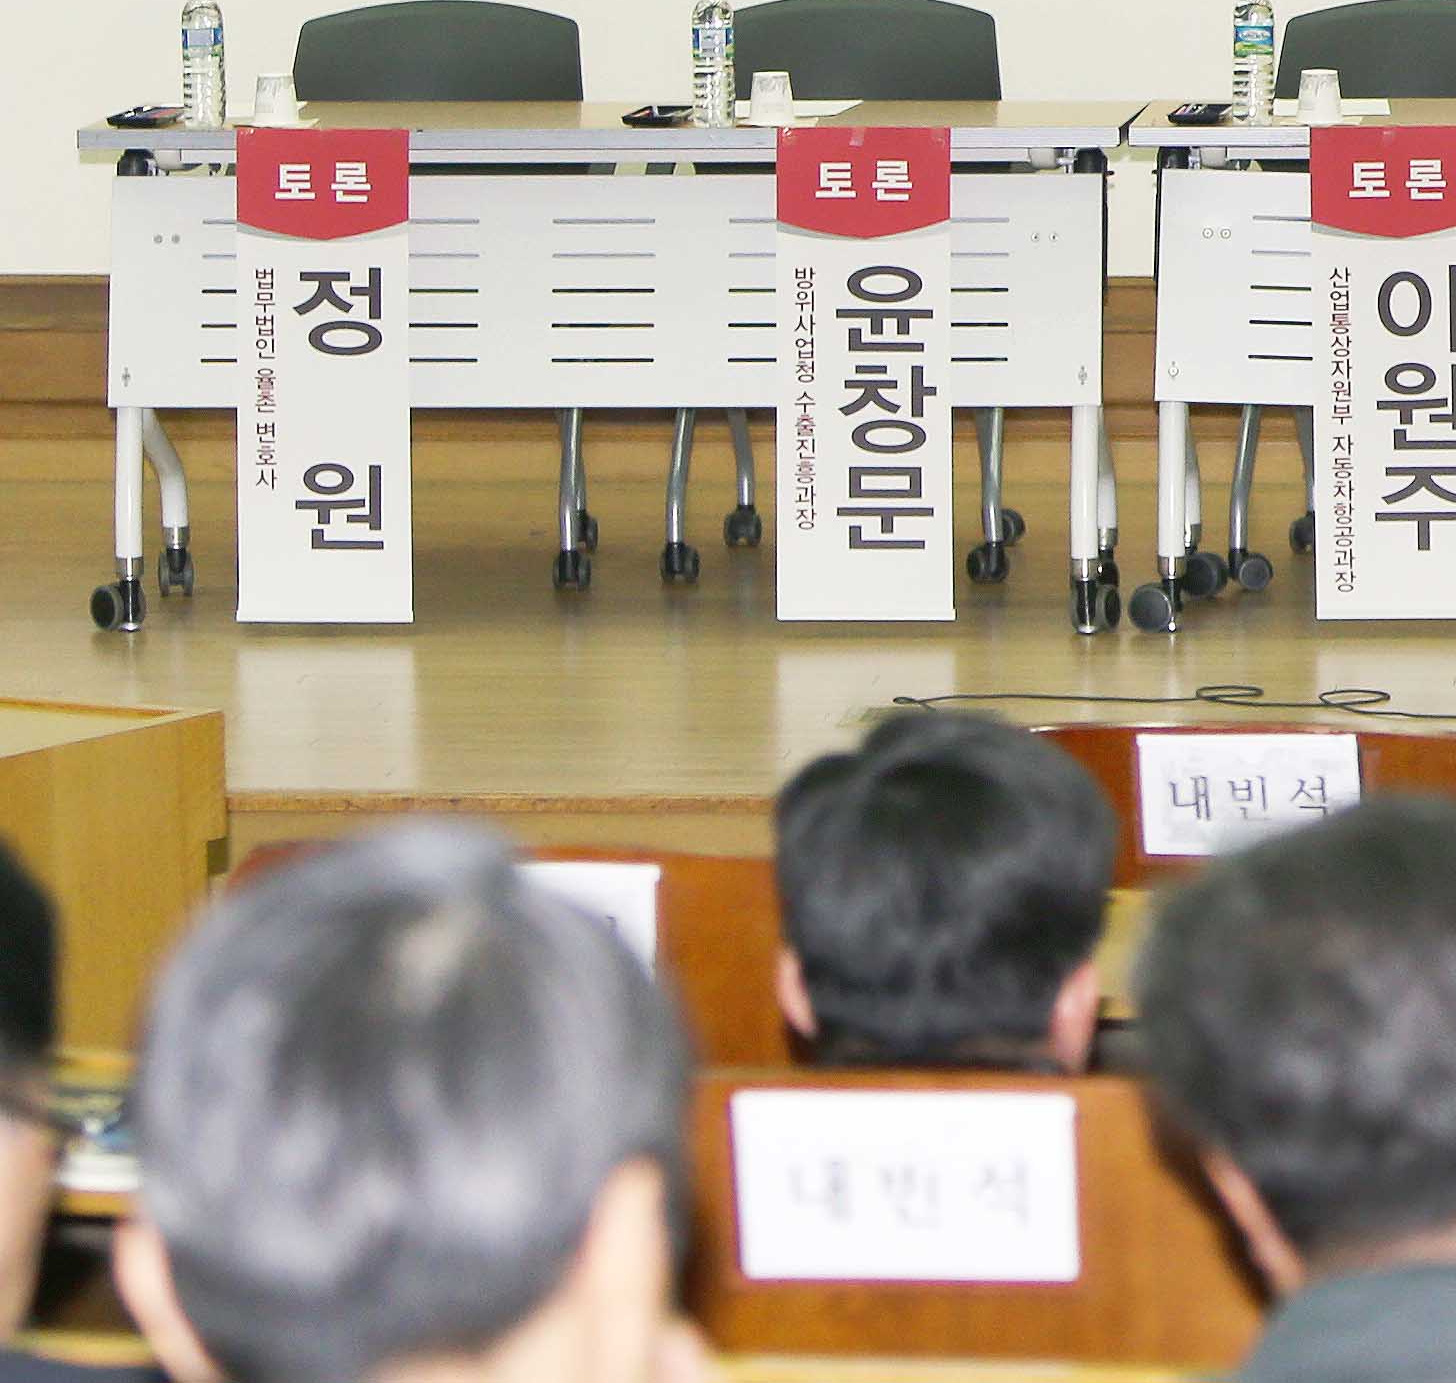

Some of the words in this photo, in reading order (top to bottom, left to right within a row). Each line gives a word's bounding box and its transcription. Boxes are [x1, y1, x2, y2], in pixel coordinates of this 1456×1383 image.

[254, 267, 276, 360] 법무법인
[794, 266, 817, 384] 방위사업청
[1329, 266, 1353, 426] 산업통상자원부
[255, 422, 277, 491] 변호사
[794, 391, 817, 530] 수출진흥과장
[835, 265, 937, 550] 윤창문
[1332, 433, 1355, 593] 자동차항공과장
